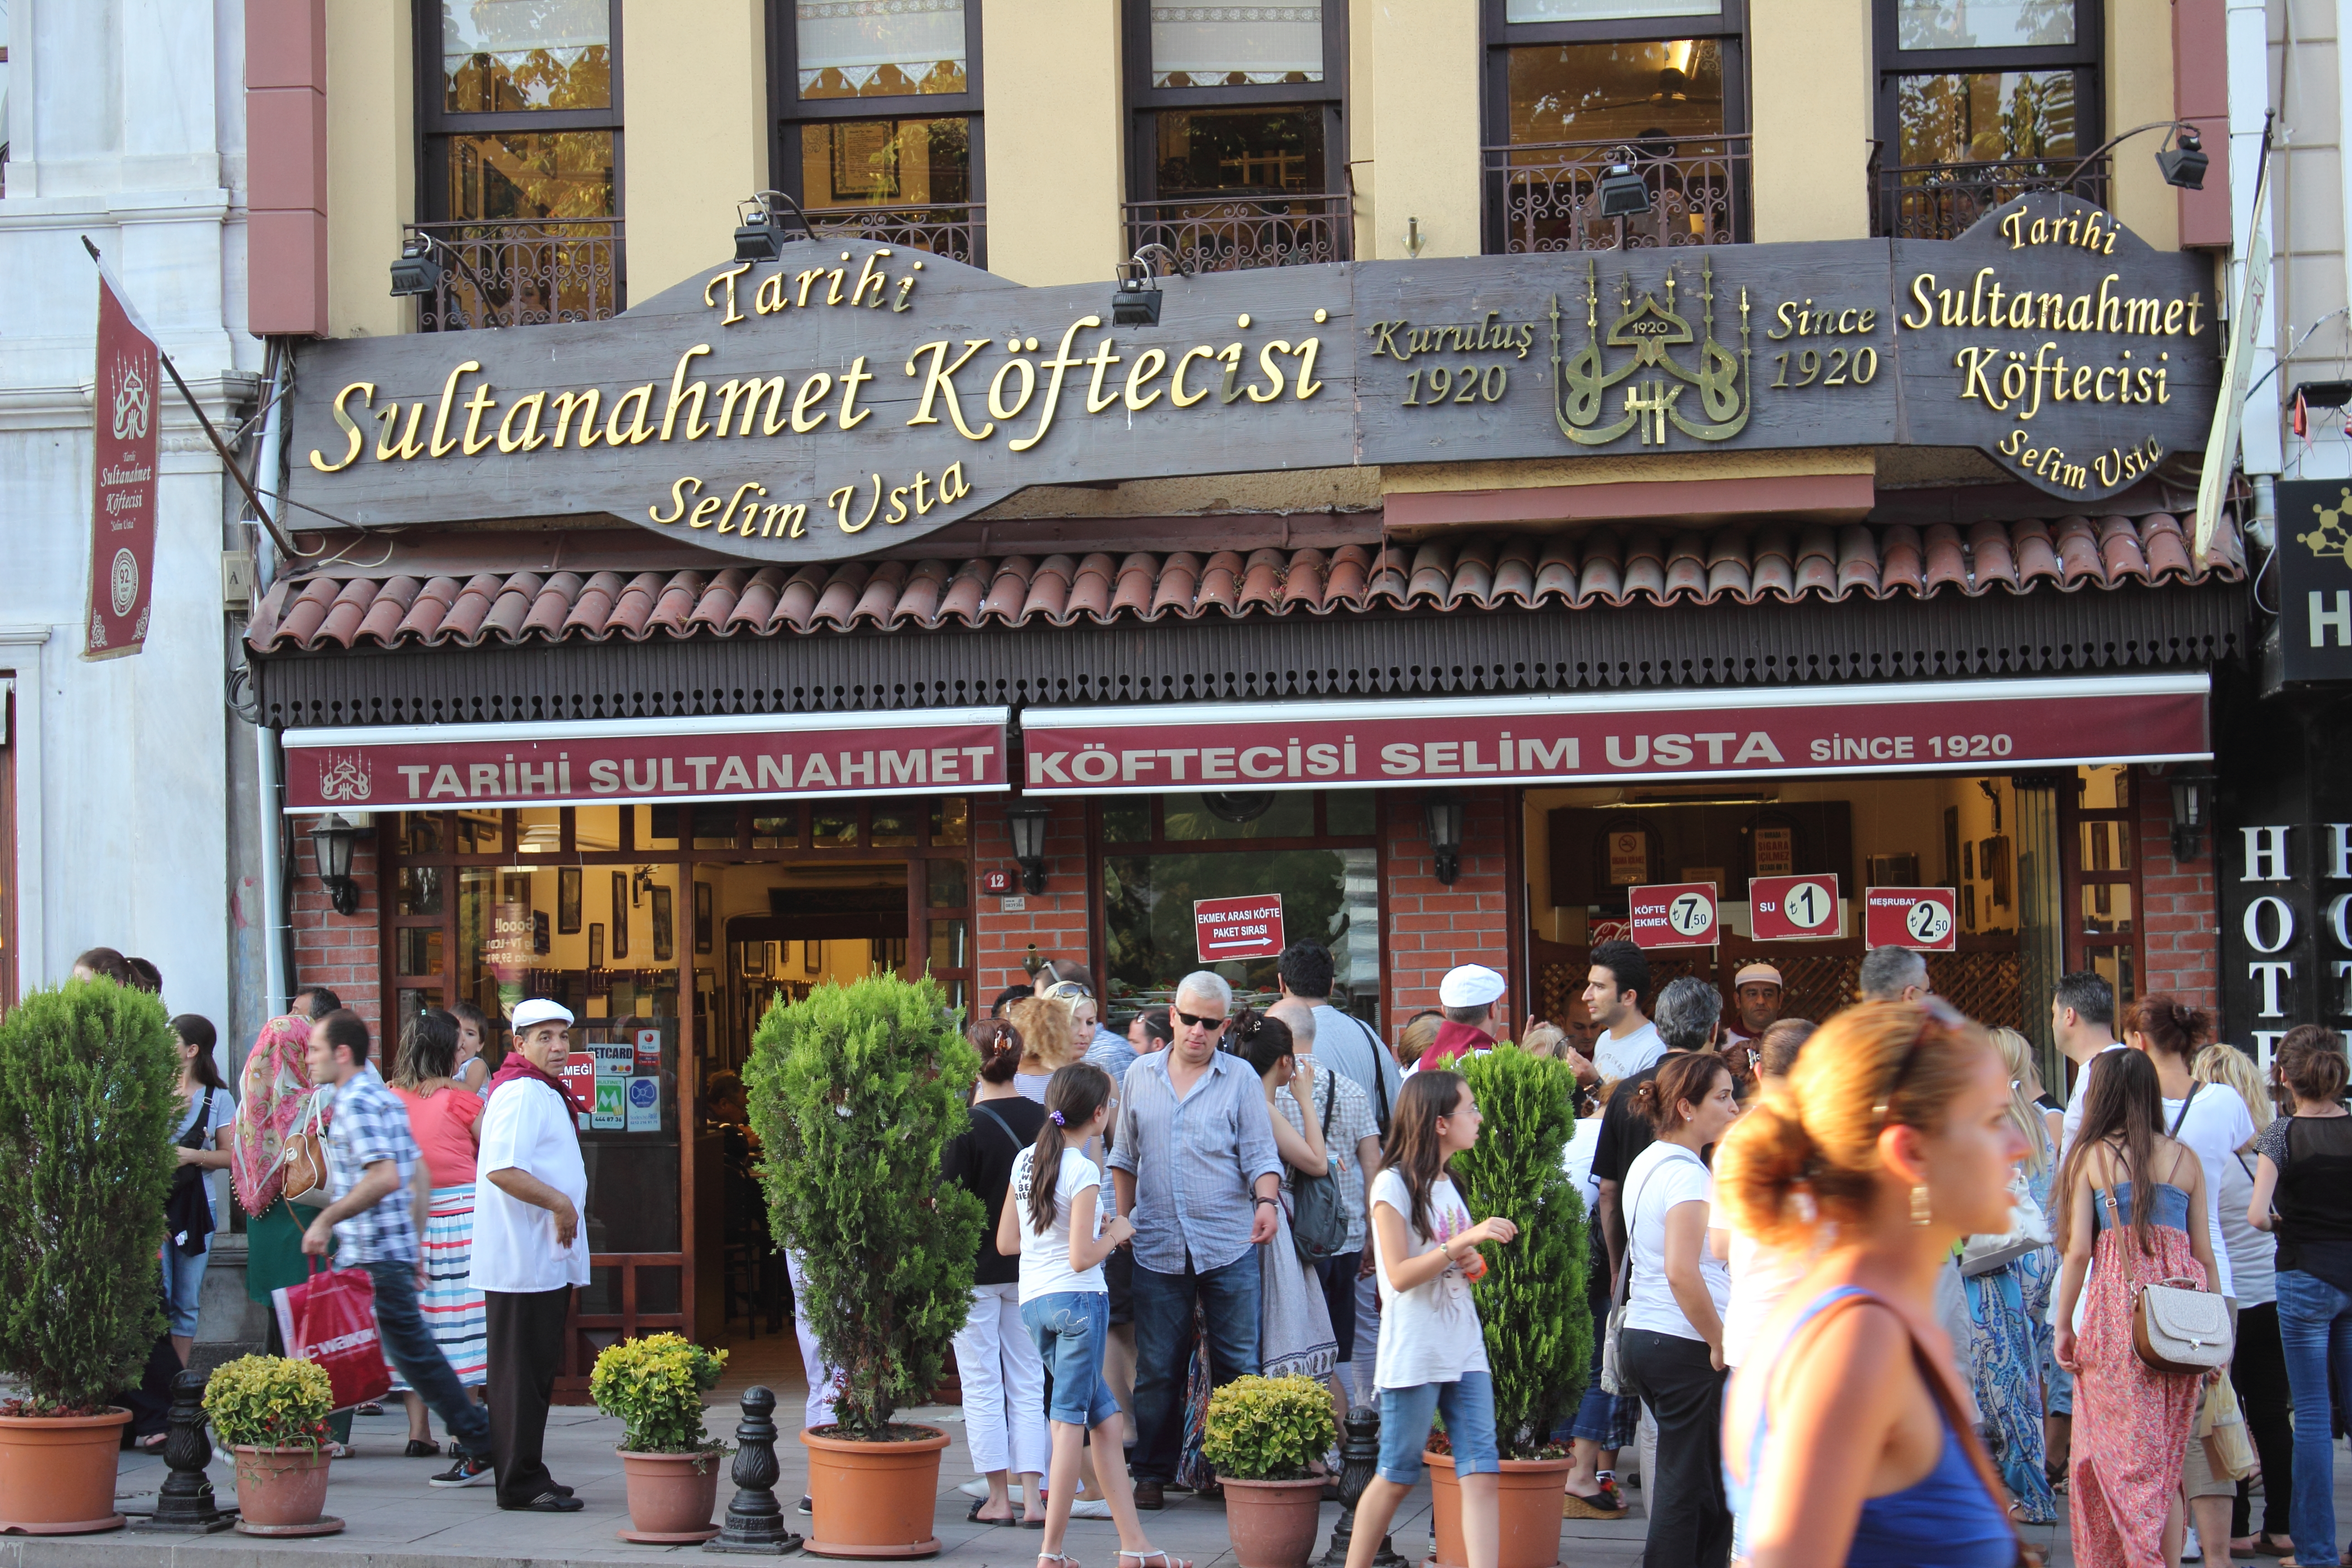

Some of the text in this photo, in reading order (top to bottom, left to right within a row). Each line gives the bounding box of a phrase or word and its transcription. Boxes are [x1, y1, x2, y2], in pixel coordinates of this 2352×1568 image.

[2003, 206, 2121, 255] Tarihi
[705, 248, 923, 326] Tarihi
[1902, 267, 2204, 336] Sultanahmet
[1633, 321, 1667, 334] 1920
[1768, 298, 1876, 339] Since
[1370, 310, 1534, 361] Kuruluş
[1771, 347, 1877, 387] 1920
[1956, 342, 2170, 419] Köftecisi
[309, 308, 1326, 472] Sultanahmet Köftecisi
[1401, 365, 1507, 405] 1920
[2000, 430, 2163, 490] Selim Usta
[101, 462, 151, 487] Sultanahmet
[106, 489, 142, 516] Köftecisi
[649, 461, 970, 539] Selim Usta
[398, 752, 571, 799] TARİHİ
[588, 746, 994, 794] SULTANAHMET
[1029, 735, 1356, 784] KÖFTECİSİ
[1380, 731, 1580, 775] SELİM
[1605, 731, 1784, 768] USTA
[1927, 733, 2013, 758] 1920
[991, 874, 1004, 887] 12
[1198, 907, 1280, 924] EKMEK ARASI KÖFTE
[1635, 905, 1666, 915] KÖFTE
[1759, 902, 1775, 912] SU
[1870, 898, 1916, 906] MEŞRUBAT
[1213, 924, 1267, 938] PAKET SIRASI
[1634, 918, 1668, 927] EKMEK
[559, 1063, 592, 1076] MEĞİ
[1023, 1153, 1034, 1164] DO
[1019, 1183, 1029, 1192] BE
